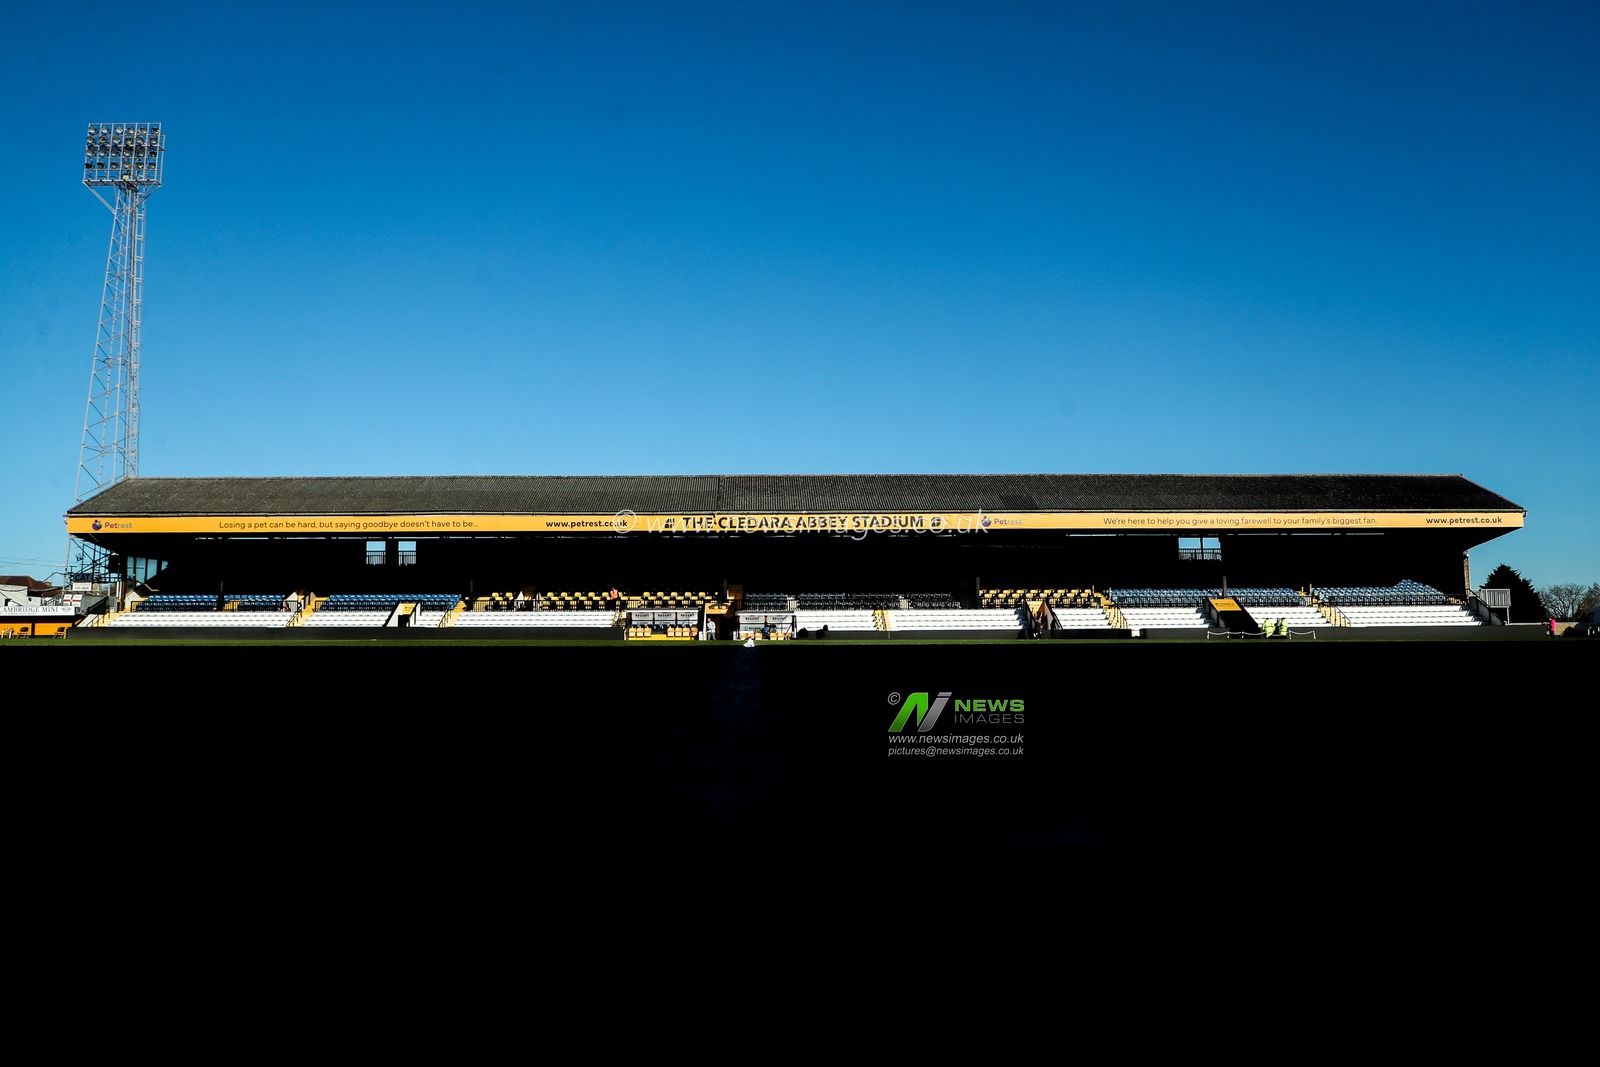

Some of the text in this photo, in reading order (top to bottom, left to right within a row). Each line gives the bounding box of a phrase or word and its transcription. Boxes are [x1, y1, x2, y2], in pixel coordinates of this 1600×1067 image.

[104, 521, 133, 529] Petrest
[219, 521, 246, 530] Losing
[253, 521, 267, 530] pet
[297, 521, 318, 529] hard,
[335, 521, 361, 530] saying
[362, 520, 399, 530] goodbye
[400, 520, 430, 528] doesn't
[431, 520, 451, 528] have
[545, 519, 628, 530] www.petrest.co.uk
[683, 516, 924, 529] THE CLEDARA ABBEY STADIUM
[993, 517, 1022, 526] Petrest
[1103, 517, 1126, 525] We're
[1127, 517, 1146, 525] here
[1157, 517, 1174, 526] help
[1191, 518, 1208, 526] give
[1216, 517, 1240, 526] loving
[1241, 517, 1272, 525] farewell
[1273, 517, 1282, 525] to
[1301, 517, 1331, 526] family's
[1332, 517, 1362, 526] biggest
[1363, 517, 1378, 525] fan.
[1425, 515, 1503, 526] www.petrest.co.uk
